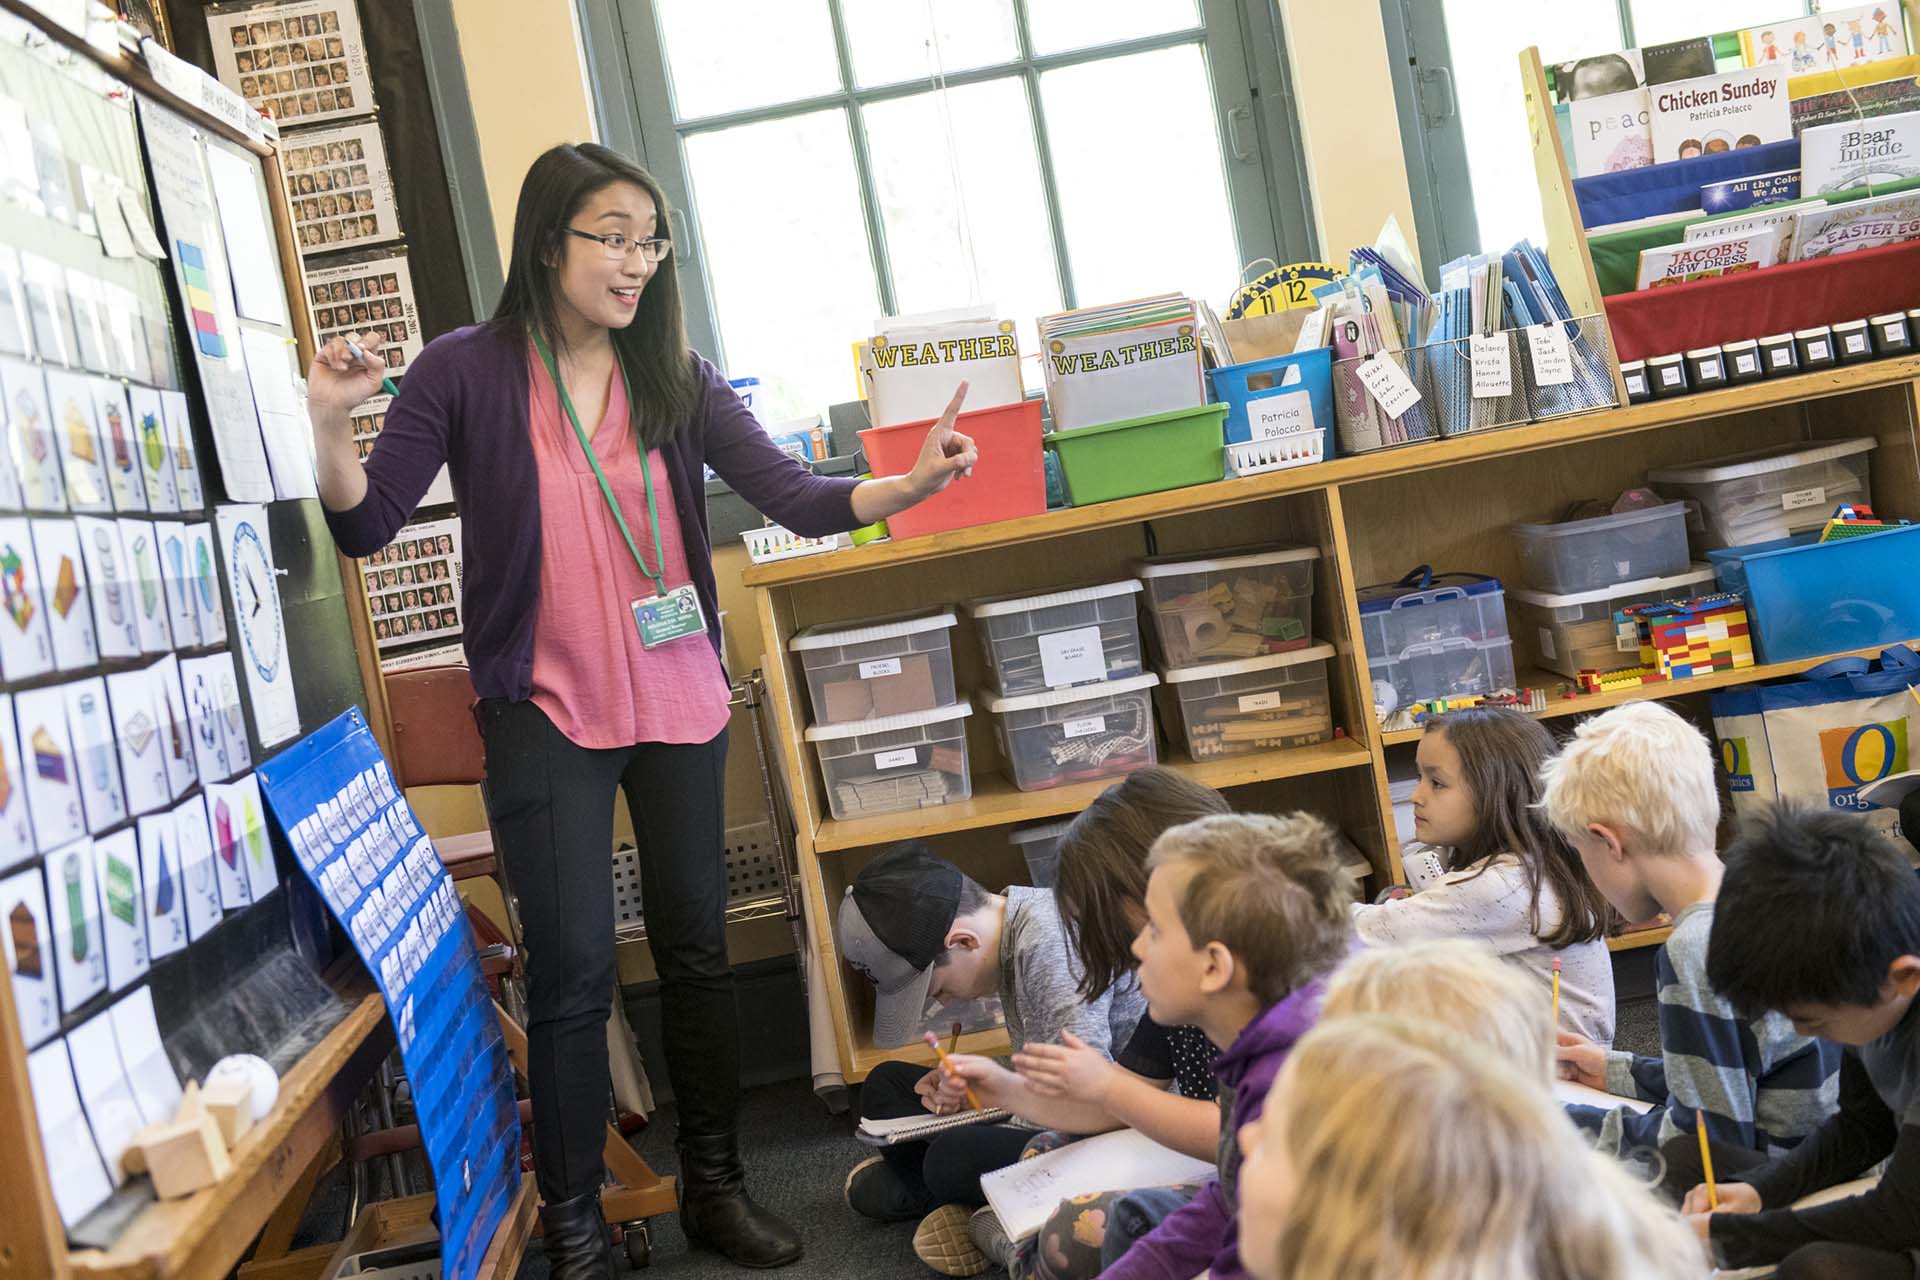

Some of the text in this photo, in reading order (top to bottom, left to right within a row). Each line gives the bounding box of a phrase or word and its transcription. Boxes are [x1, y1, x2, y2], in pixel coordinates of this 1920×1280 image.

[1658, 77, 1777, 113] Chicken Sunday
[1690, 103, 1752, 121] Patricia Polacco
[1846, 128, 1896, 148] Bear
[1839, 142, 1903, 163] Inside
[1732, 183, 1748, 193] All
[1752, 180, 1771, 190] the
[1752, 186, 1788, 198] We Are
[1695, 223, 1753, 239] PATRICIA
[1826, 223, 1894, 244] EASTER
[1666, 253, 1748, 276] NEW DRESS
[1668, 240, 1749, 268] JACOB'S
[1286, 280, 1308, 303] 12
[1260, 294, 1276, 315] 11
[872, 334, 1017, 369] WEATHER
[1051, 335, 1197, 376] WEATHER
[1474, 343, 1505, 355] Delaney
[1261, 408, 1300, 424] Patricia
